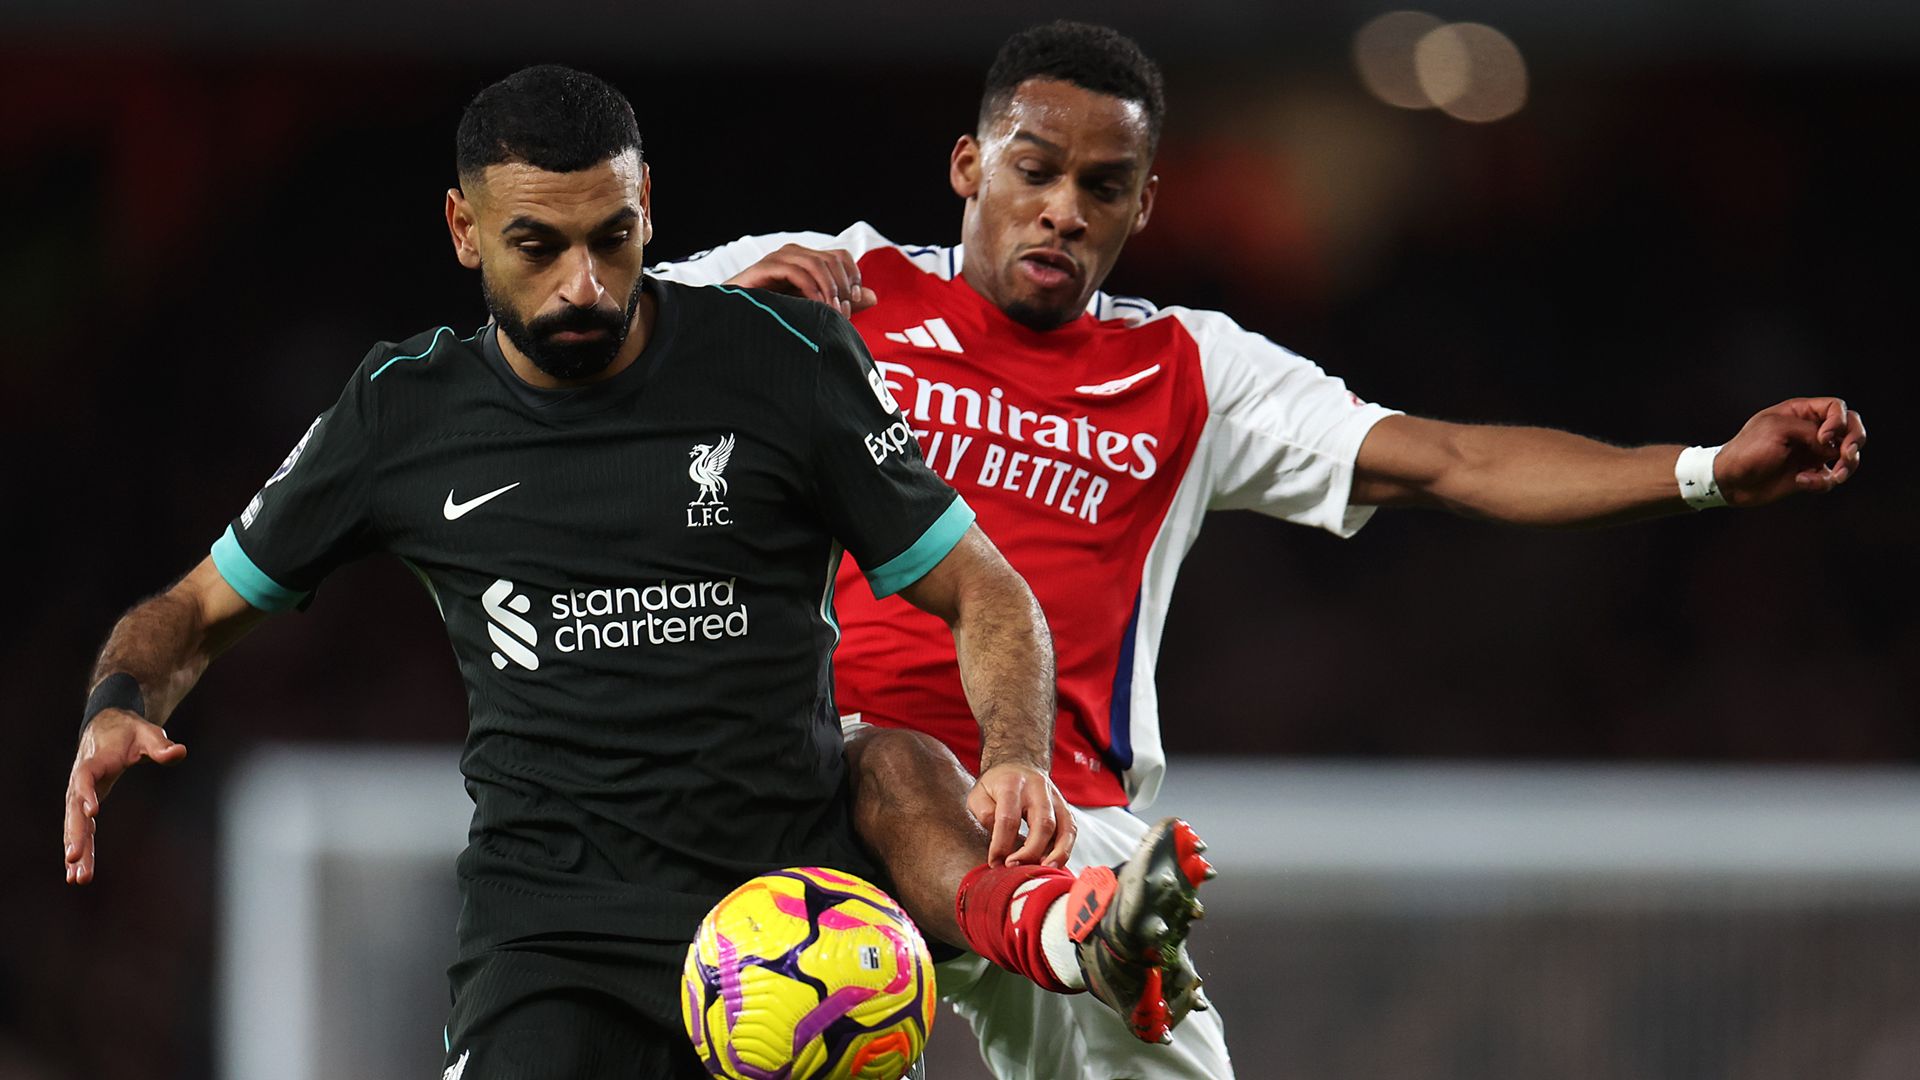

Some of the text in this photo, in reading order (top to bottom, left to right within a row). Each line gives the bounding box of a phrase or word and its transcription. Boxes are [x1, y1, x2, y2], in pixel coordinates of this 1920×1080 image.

[875, 361, 1159, 480] Emirates
[976, 443, 1110, 525] BETTER
[686, 505, 734, 527] L.F.C.
[551, 577, 737, 620] standard
[554, 604, 749, 653] chartered
